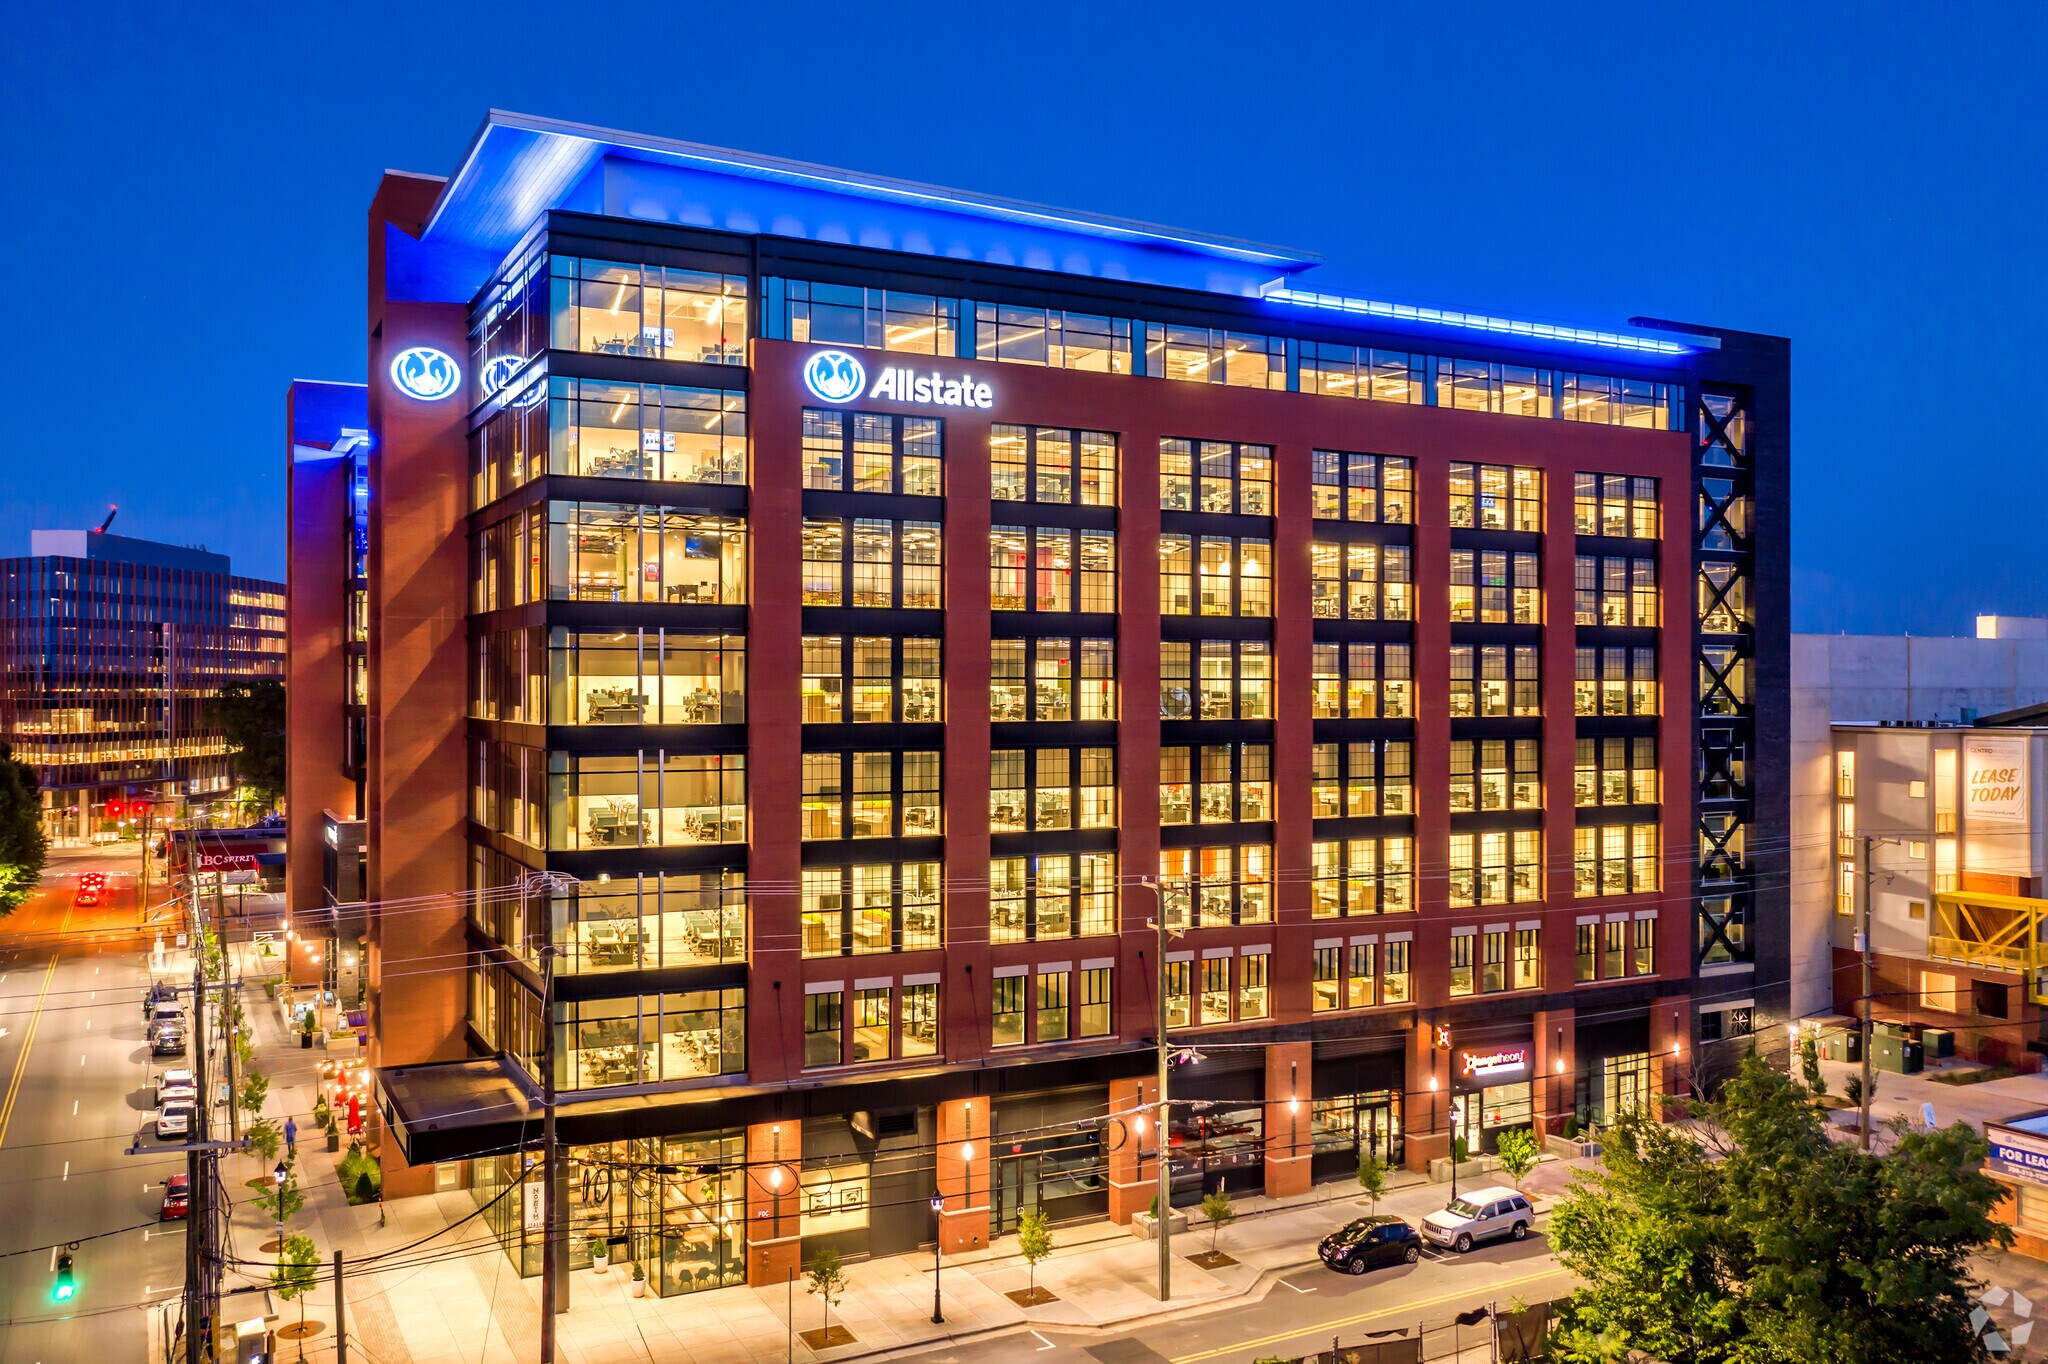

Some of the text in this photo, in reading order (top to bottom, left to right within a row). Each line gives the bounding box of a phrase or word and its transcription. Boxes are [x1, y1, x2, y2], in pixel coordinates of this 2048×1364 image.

[869, 367, 993, 409] Allstate
[1972, 768, 2020, 785] LEASE
[1972, 786, 2021, 803] TODAY
[200, 854, 223, 867] BC
[1999, 1147, 2023, 1163] FOR
[532, 1187, 540, 1221] NORTH
[758, 1209, 770, 1218] FDC
